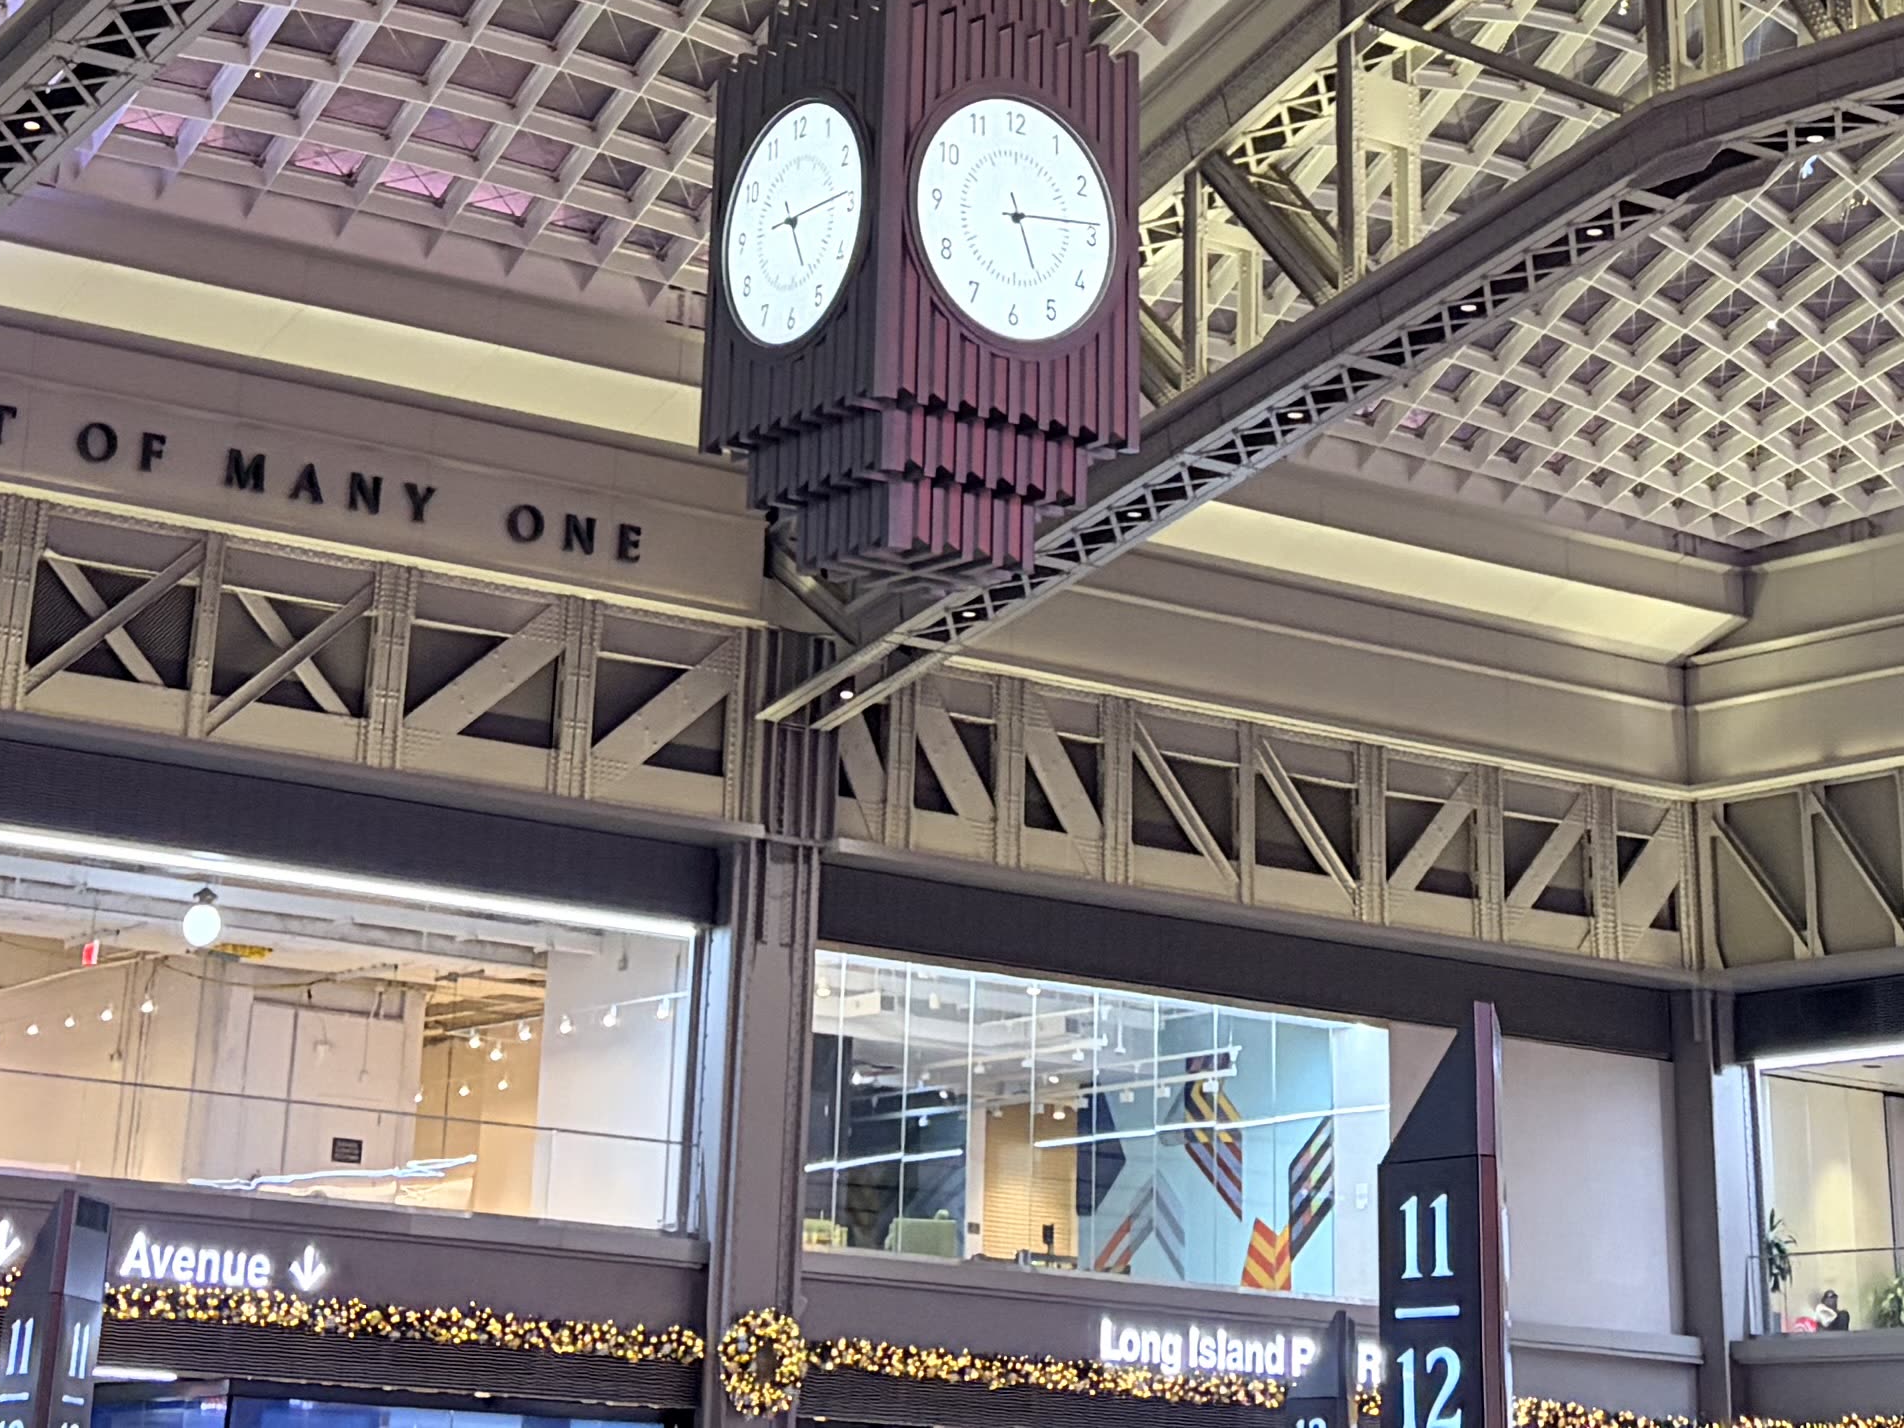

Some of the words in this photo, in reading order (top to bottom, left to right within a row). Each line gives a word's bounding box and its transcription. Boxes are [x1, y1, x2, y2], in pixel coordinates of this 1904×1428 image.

[793, 115, 807, 141] 12
[826, 117, 831, 139] 1
[970, 112, 985, 137] 11
[1006, 111, 1026, 136] 12
[768, 138, 779, 161] 11
[841, 144, 849, 167] 2
[939, 141, 959, 165] 10
[1052, 134, 1059, 155] 1
[746, 180, 759, 204] 10
[1076, 175, 1088, 197] 2
[846, 190, 855, 212] 3
[931, 187, 942, 210] 9
[738, 232, 746, 256] 9
[1086, 226, 1097, 247] 3
[940, 237, 952, 260] 8
[742, 275, 751, 297] 8
[1074, 269, 1085, 290] 4
[814, 284, 823, 307] 5
[968, 280, 980, 303] 7
[760, 303, 769, 327] 7
[786, 307, 795, 330] 6
[1008, 303, 1019, 326] 6
[1046, 298, 1057, 321] 5
[76, 422, 168, 473] OF
[223, 448, 437, 523] MANY
[506, 503, 642, 563] ONE
[1399, 1193, 1455, 1280] 11
[119, 1230, 272, 1287] Avenue
[6, 1317, 34, 1376] 11
[69, 1322, 90, 1379] 11
[1099, 1317, 1182, 1375] Long
[1189, 1325, 1285, 1377] Island
[1395, 1346, 1463, 1428] 12
